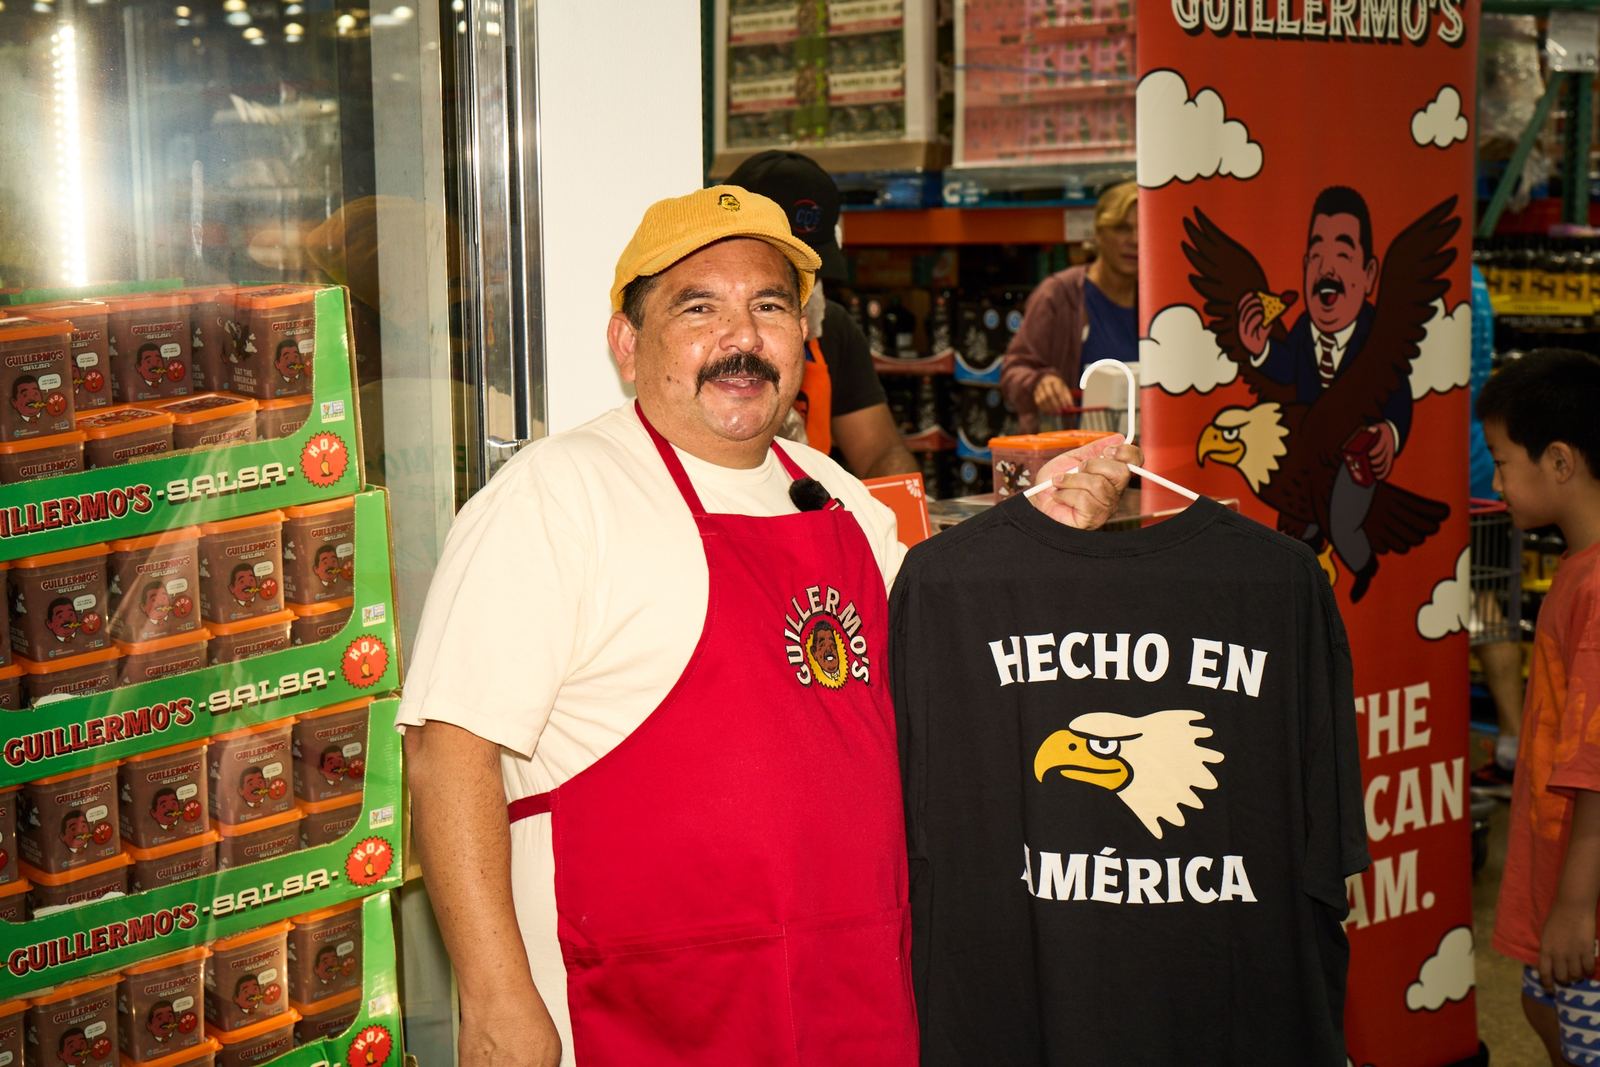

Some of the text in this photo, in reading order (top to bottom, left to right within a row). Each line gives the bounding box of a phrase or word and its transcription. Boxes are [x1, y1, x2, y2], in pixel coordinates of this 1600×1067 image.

[1172, 0, 1466, 48] GUILLERMO'S
[5, 350, 64, 367] GUILLERMO'S
[113, 440, 168, 460] GUILLERMO'S
[308, 438, 340, 457] HOT
[20, 458, 77, 477] GUILLERMO'S
[226, 539, 277, 556] GUILLERMO'S
[136, 555, 191, 574] GUILLERMO'S
[41, 571, 99, 590] GUILLERMO'S
[784, 585, 870, 686] GUILLERMO'S
[349, 641, 380, 661] HOT
[988, 631, 1269, 698] HECHO EN
[4, 697, 195, 768] GUILLERMO'S
[147, 761, 200, 782] GUILLERMO'S
[56, 782, 112, 804] GUILLERMO'S
[1364, 757, 1465, 842] CAN
[354, 842, 385, 861] HOT
[8, 903, 199, 976] GUILLERMO'S
[144, 973, 198, 995] GUILLERMO'S
[53, 1000, 109, 1023] GUILLERMO'S
[354, 1031, 385, 1050] HOT
